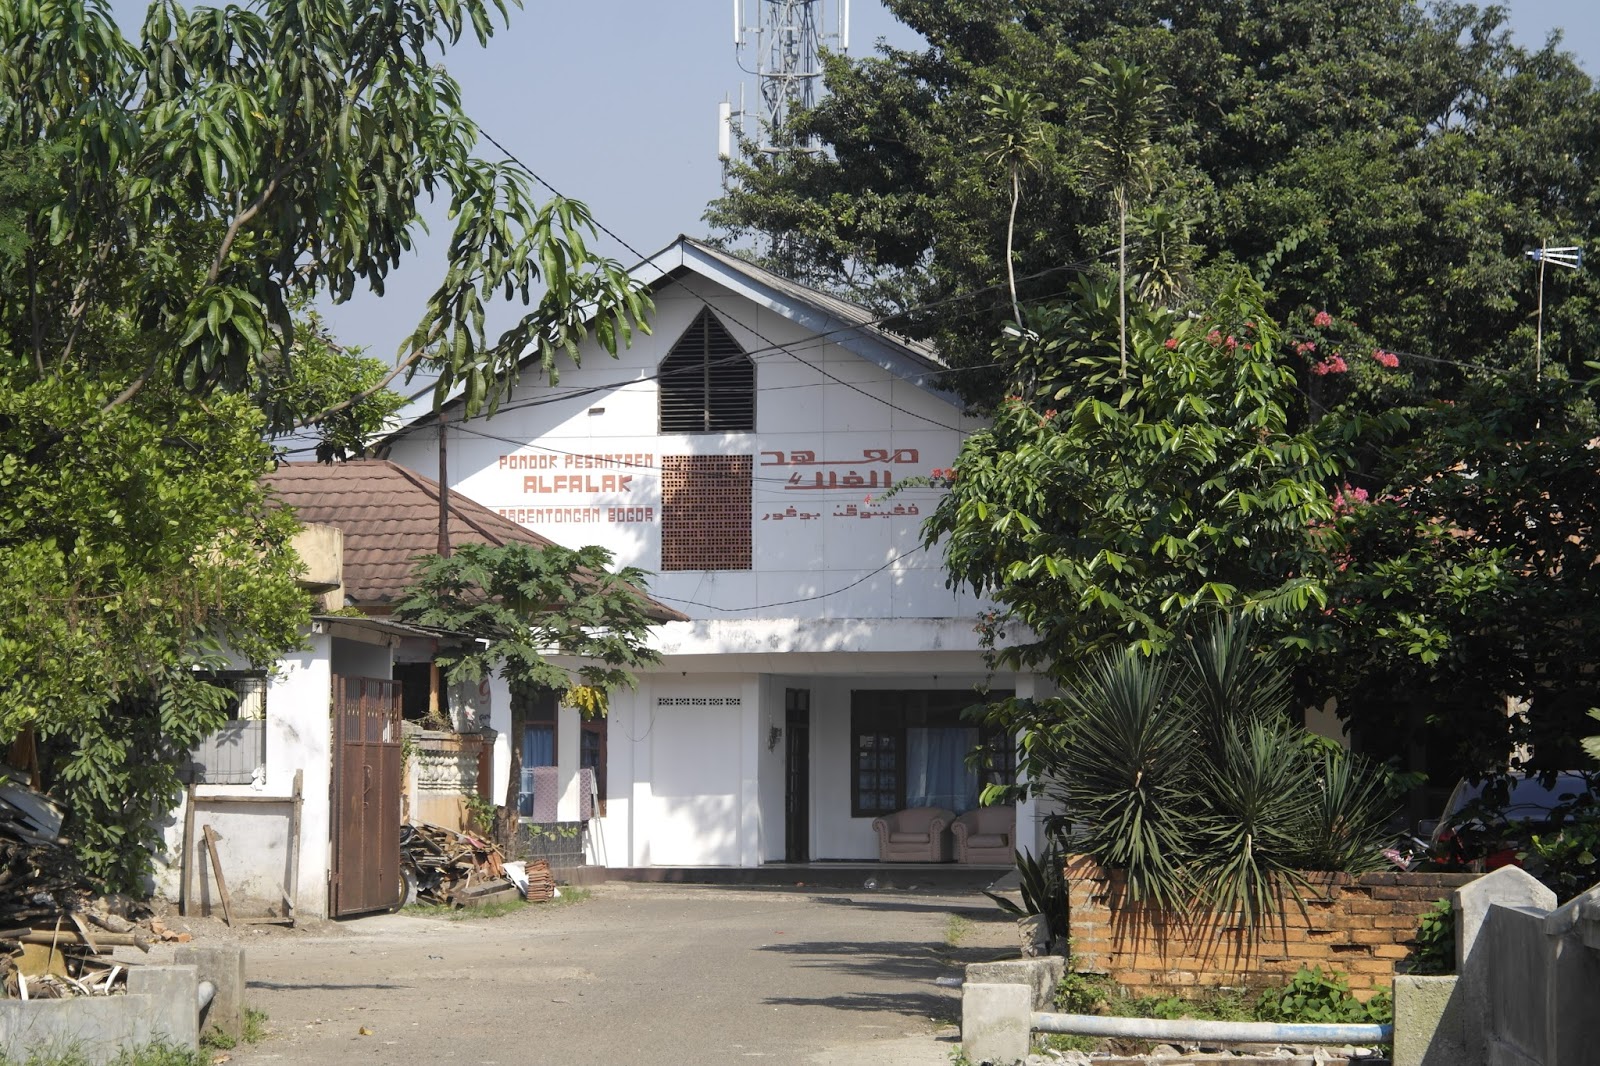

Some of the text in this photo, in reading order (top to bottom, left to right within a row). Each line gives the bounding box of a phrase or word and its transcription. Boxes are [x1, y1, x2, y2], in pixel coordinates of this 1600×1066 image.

[499, 453, 653, 469] PONDOK PESANTREN
[761, 448, 918, 466] معهد
[523, 474, 633, 493] ALFALAK
[607, 508, 653, 522] BOGOR
